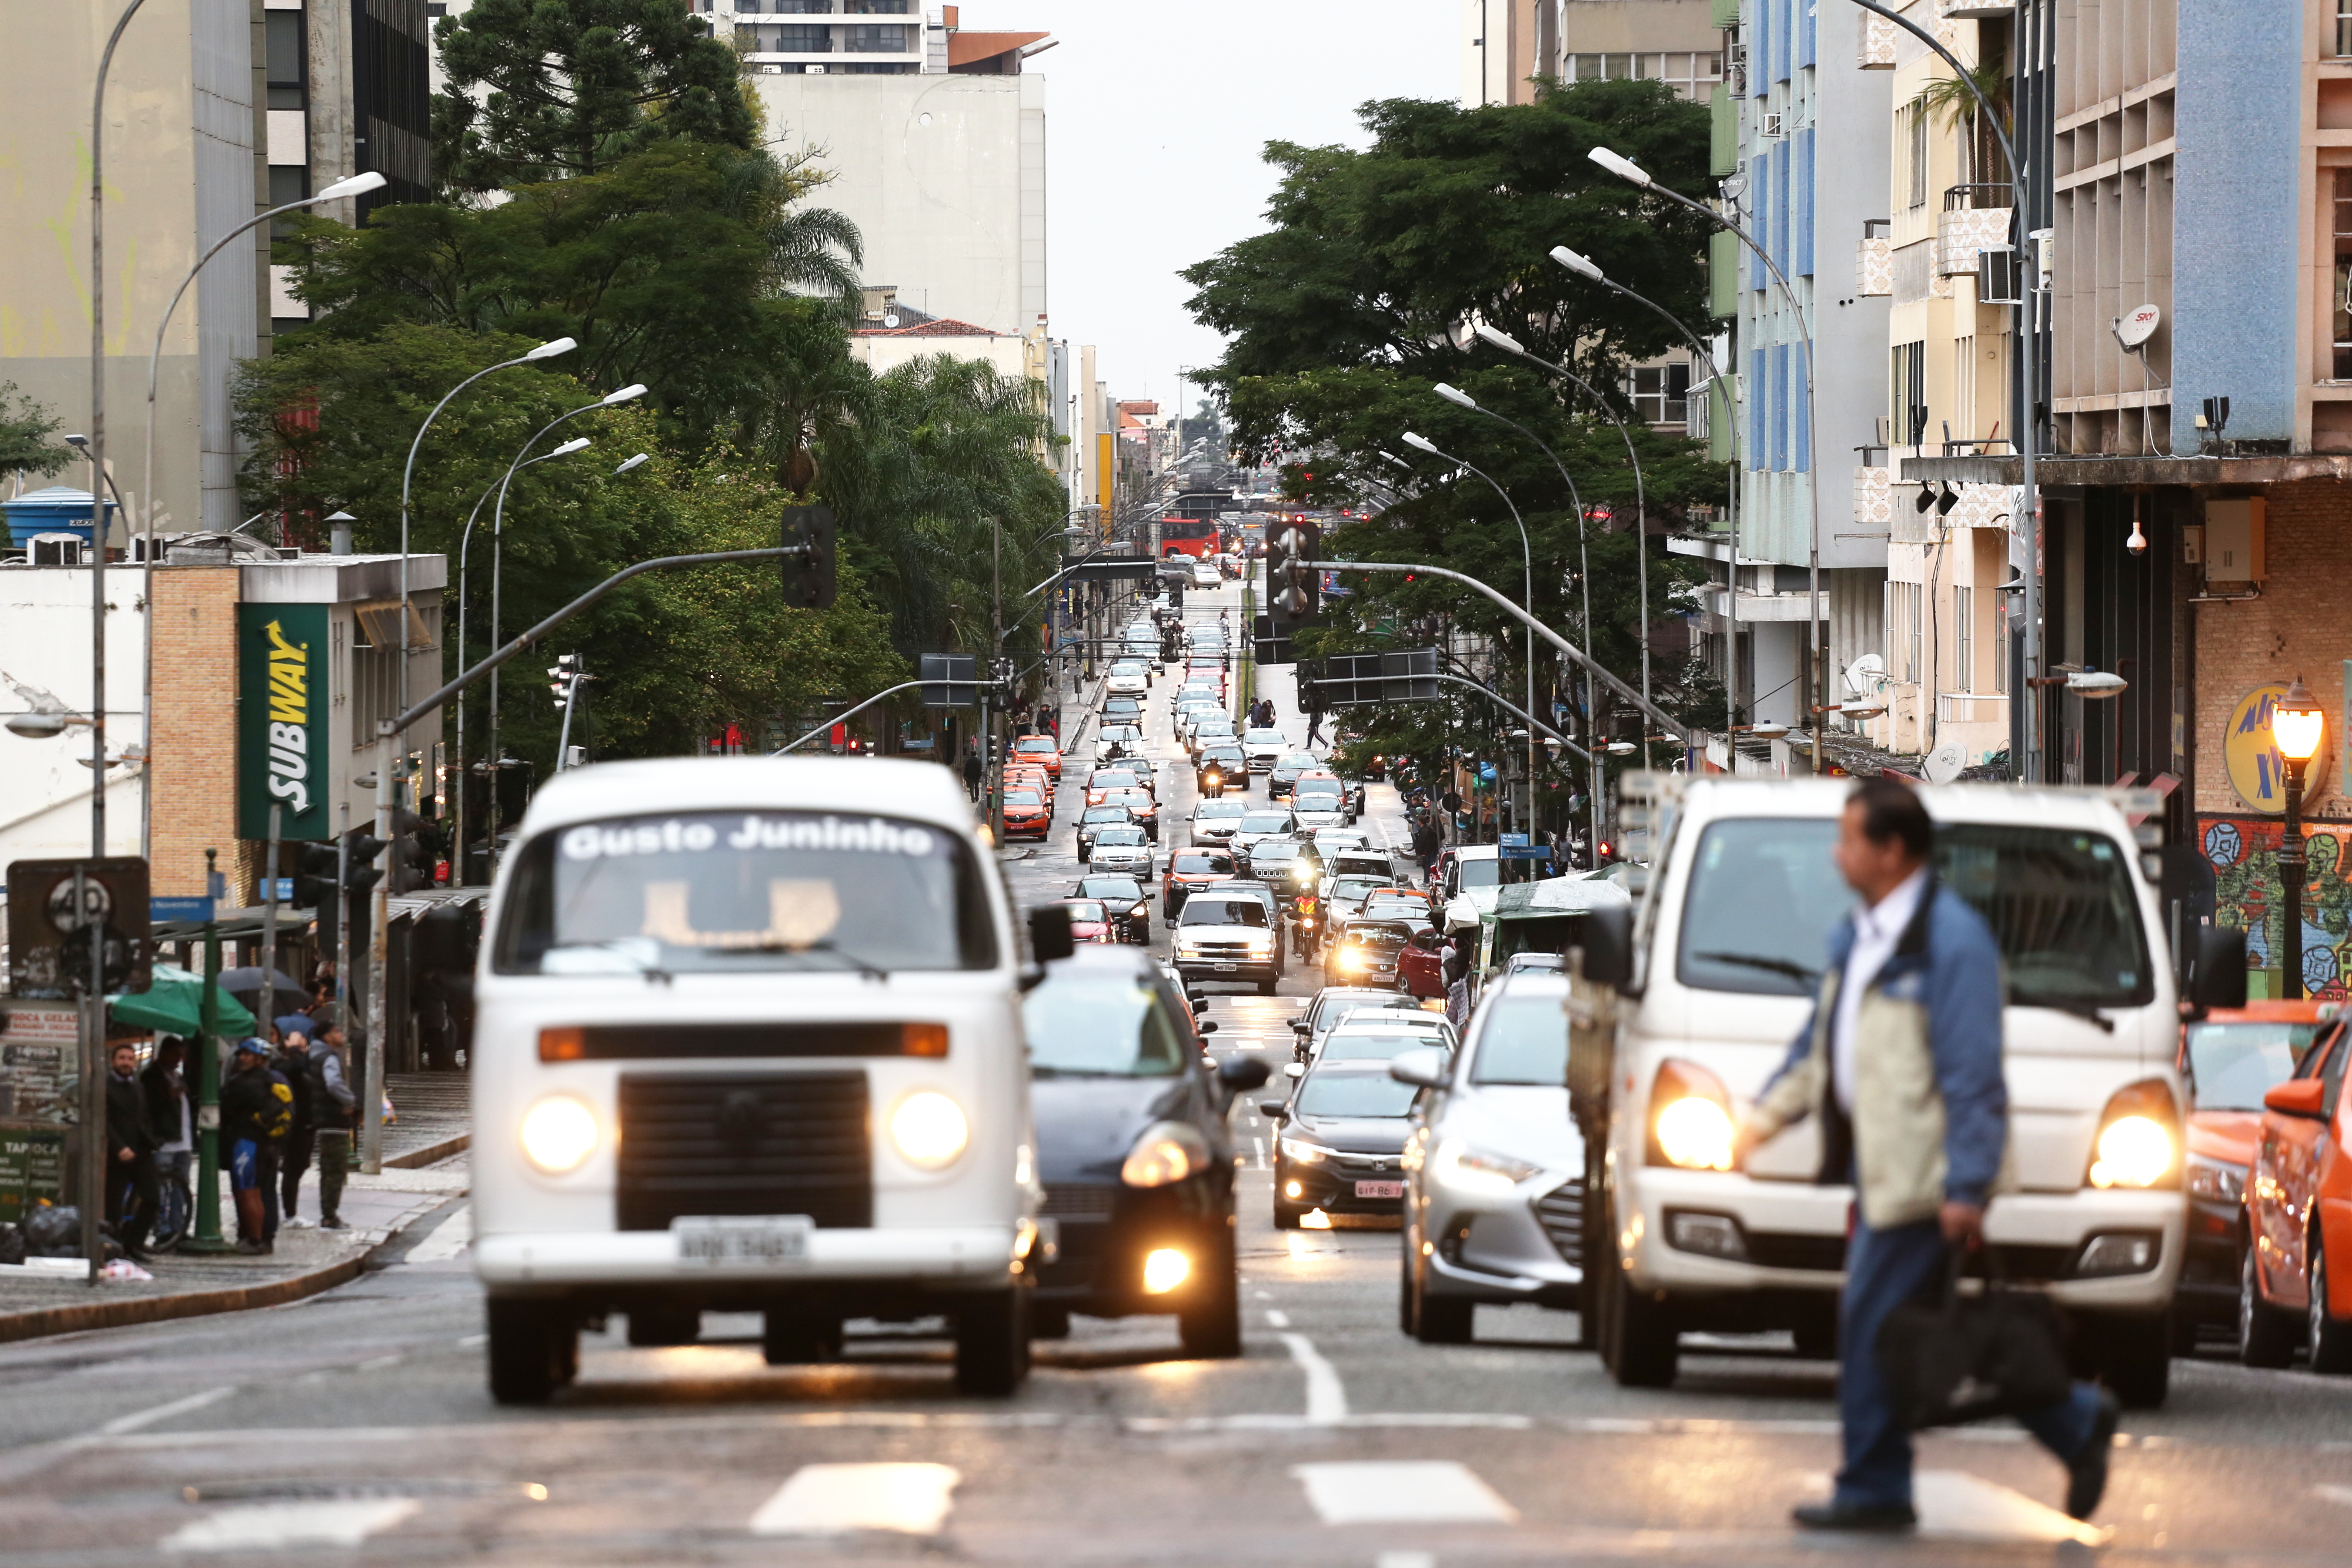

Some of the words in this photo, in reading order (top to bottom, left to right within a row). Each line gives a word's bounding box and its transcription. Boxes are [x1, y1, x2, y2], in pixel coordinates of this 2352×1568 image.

[2135, 311, 2157, 322] SKY
[264, 620, 308, 813] SUBWAY
[728, 816, 933, 856] Juninho
[155, 901, 200, 909] Novembro
[5, 1142, 59, 1155] TAPOCA
